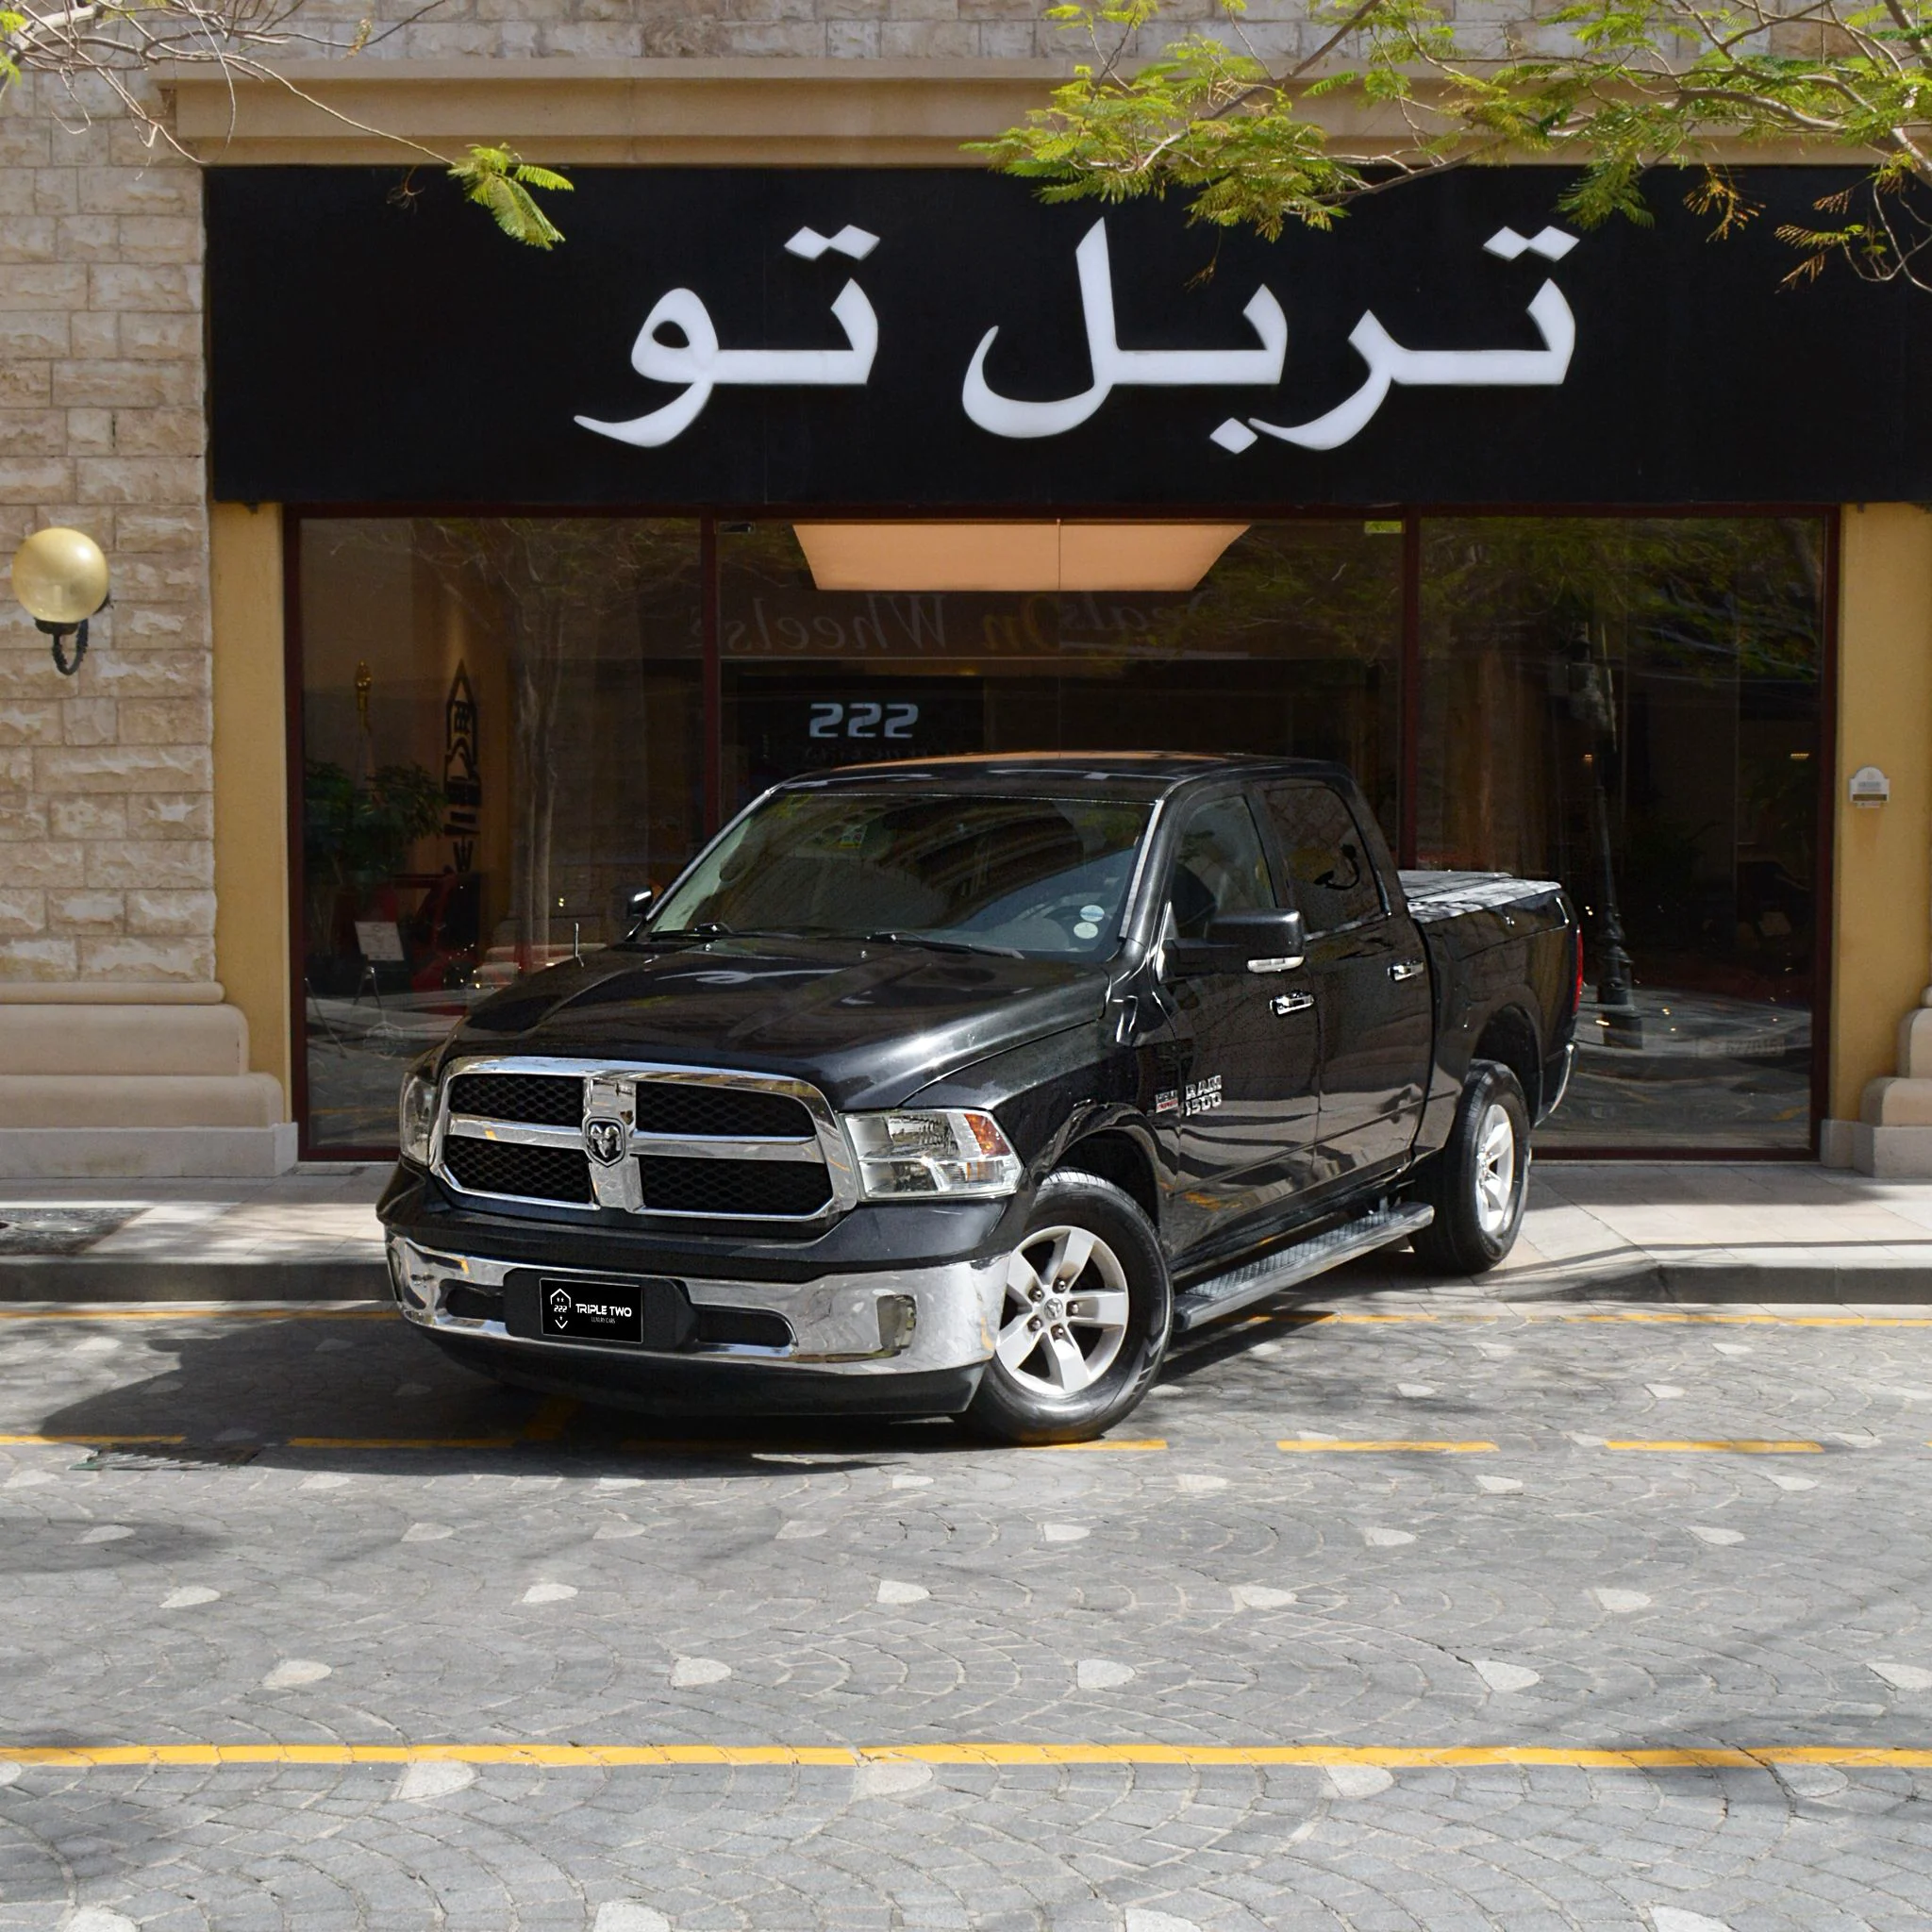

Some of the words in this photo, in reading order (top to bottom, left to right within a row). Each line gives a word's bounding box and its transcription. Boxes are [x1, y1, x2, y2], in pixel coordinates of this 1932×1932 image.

[574, 225, 880, 448] تو
[962, 217, 1579, 454] تربل
[808, 702, 920, 739] 222
[1185, 1075, 1223, 1101] RAM
[1185, 1091, 1223, 1117] 1500
[553, 1304, 568, 1313] 222
[575, 1303, 608, 1316] TRIPLE
[608, 1306, 632, 1318] TWO
